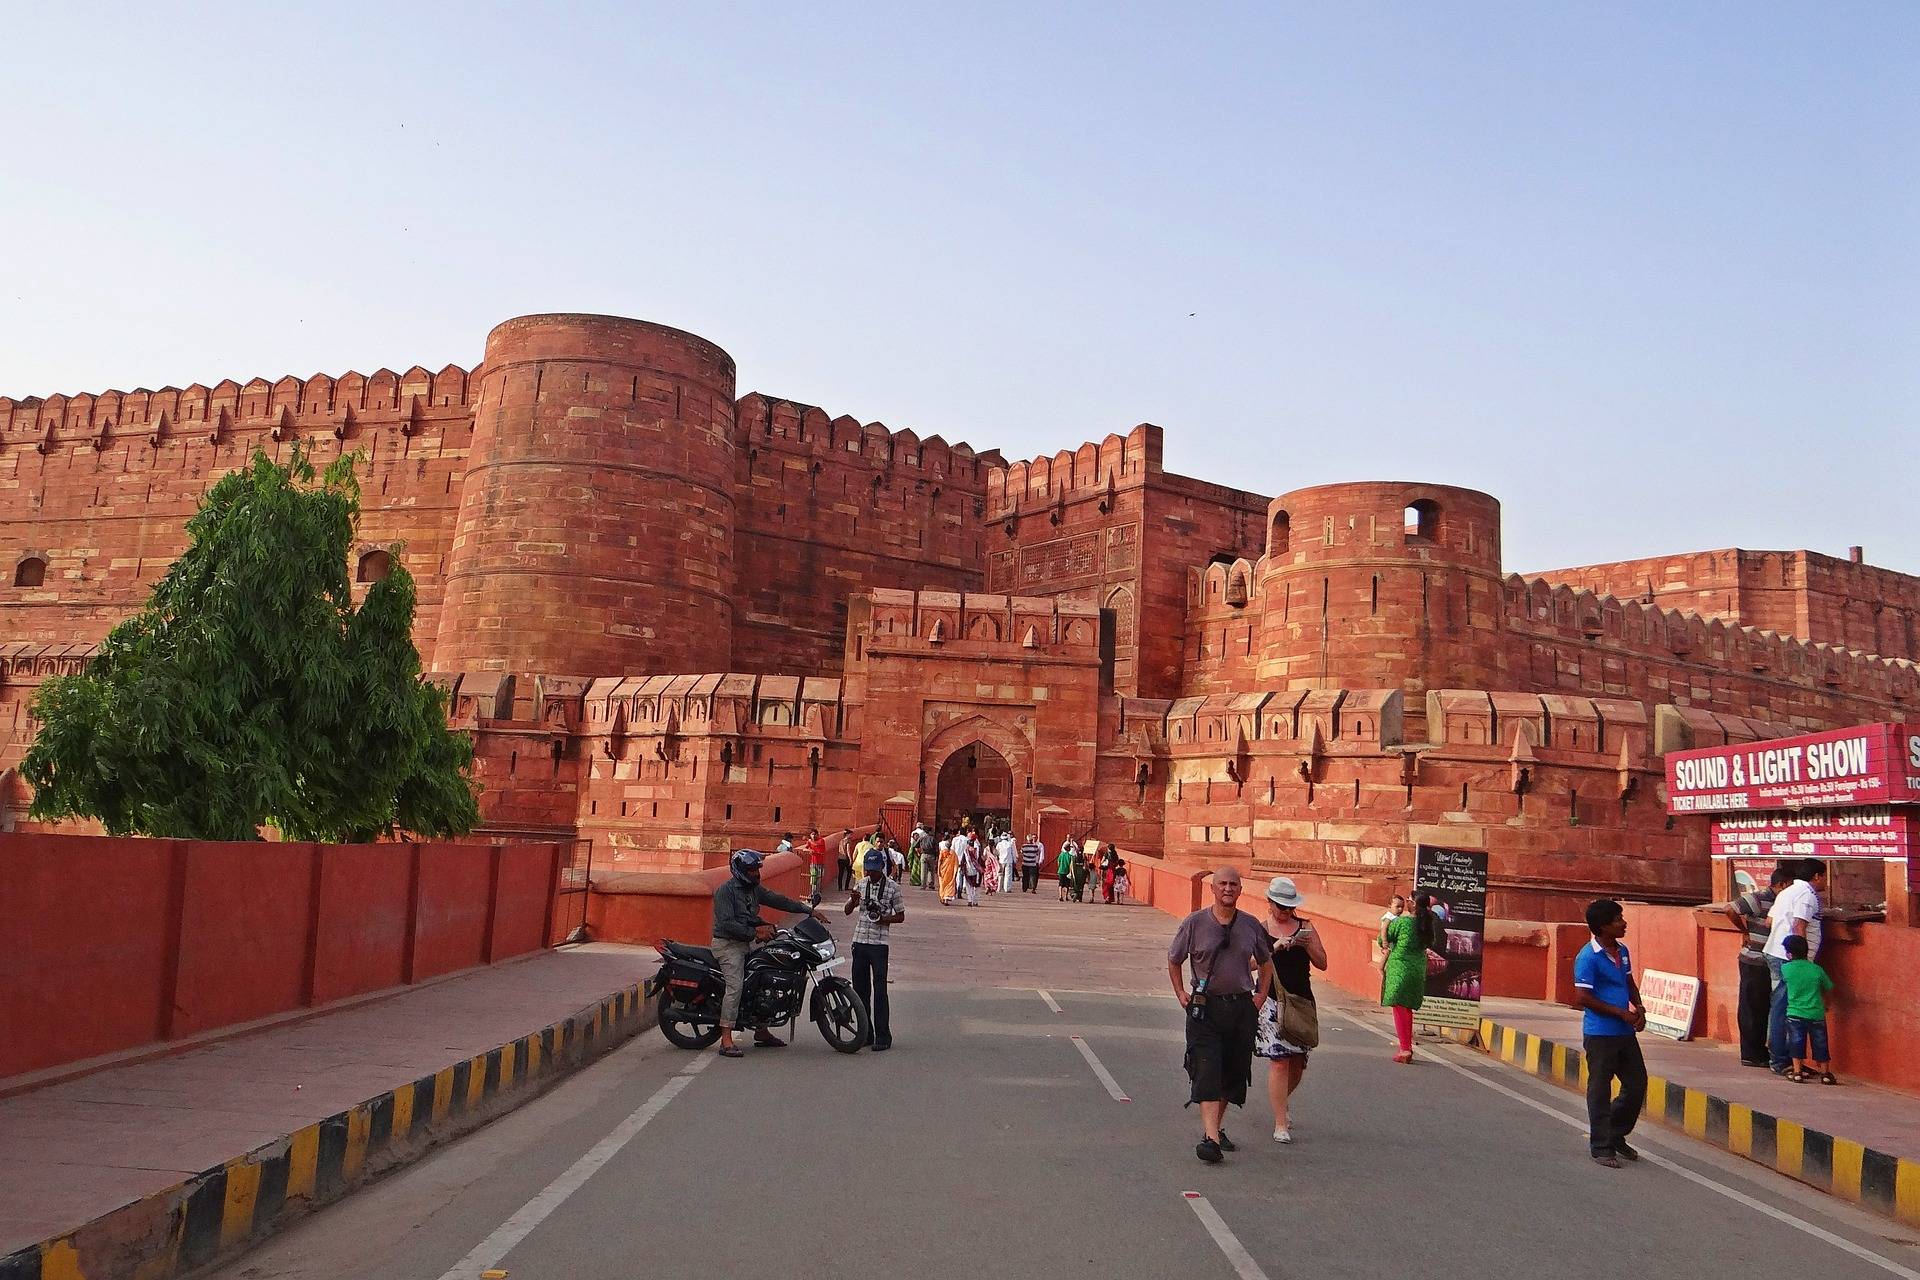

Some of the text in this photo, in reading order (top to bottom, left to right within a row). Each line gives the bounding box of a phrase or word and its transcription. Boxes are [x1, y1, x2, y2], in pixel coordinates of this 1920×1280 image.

[1675, 756, 1728, 791] SOUND
[1732, 755, 1745, 787] &
[1748, 746, 1802, 785] LIGHT
[1806, 737, 1867, 780] SHOW
[1672, 792, 1748, 811] TICKET AVAILABLE HERE
[1719, 806, 1891, 829] SOUND & LIGHT SHOW
[1416, 877, 1486, 893] Sound & Light Show
